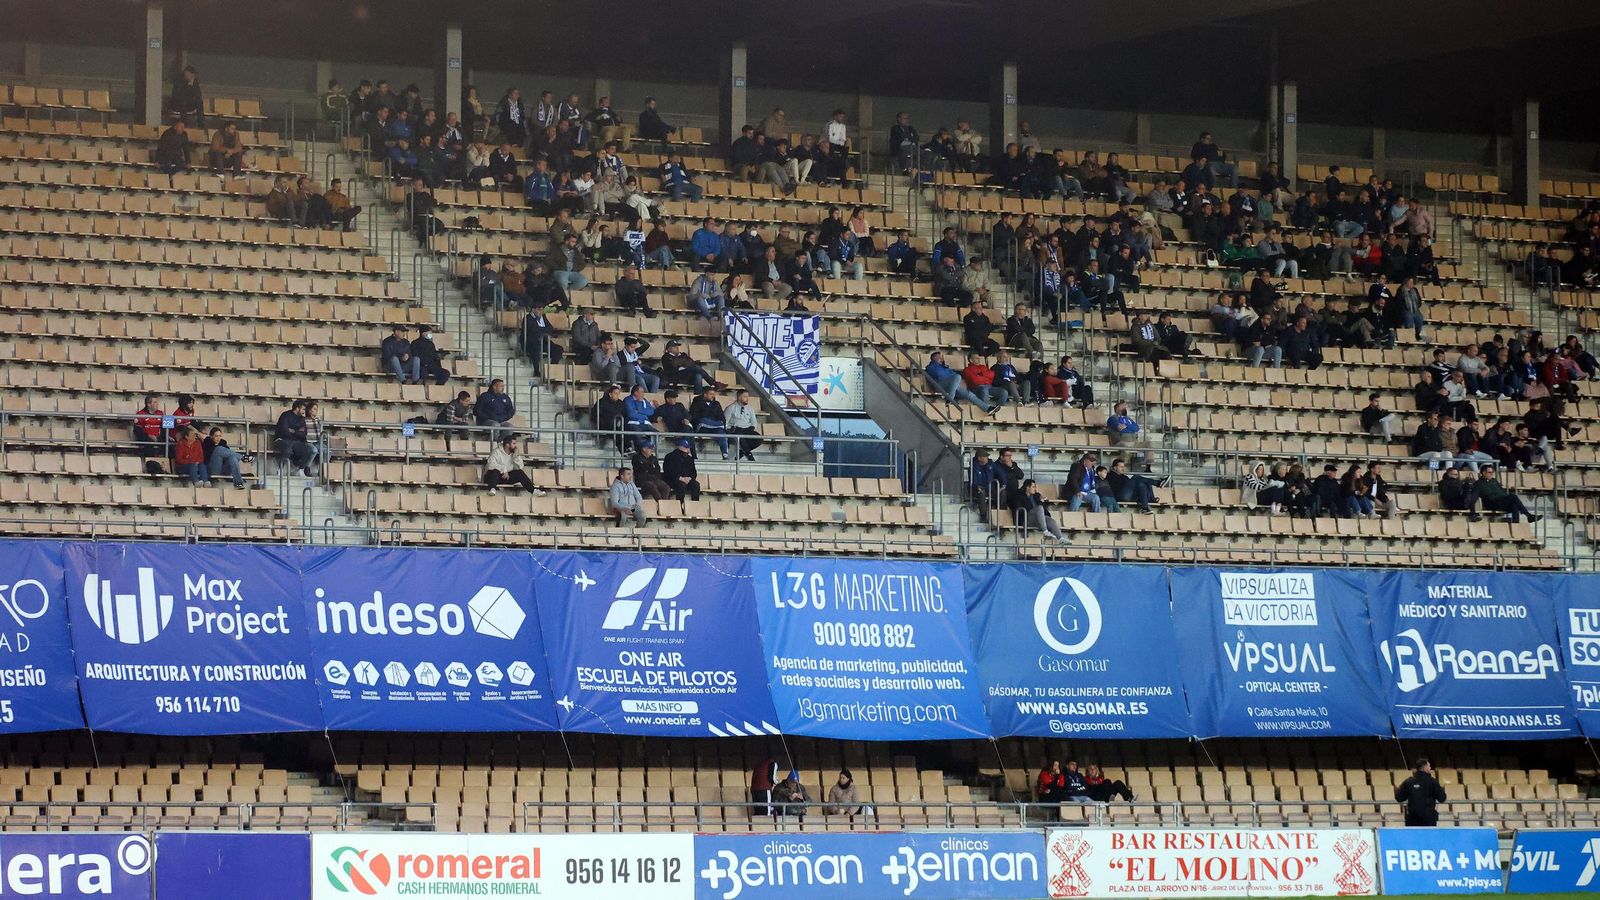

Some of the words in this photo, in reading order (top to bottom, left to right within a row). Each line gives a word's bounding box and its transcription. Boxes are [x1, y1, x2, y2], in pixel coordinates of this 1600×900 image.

[184, 574, 243, 601] Max
[771, 572, 826, 609] L3G
[834, 573, 948, 613] MARKETING.
[1224, 578, 1308, 595] VIPSUALIZA
[1428, 585, 1492, 599] MATERIAL
[315, 588, 465, 636] indeso
[642, 601, 692, 631] Air
[1058, 604, 1080, 632] G
[1226, 604, 1243, 620] LA
[1244, 604, 1314, 620] VICTORIA
[1399, 602, 1446, 618] MÉDICO
[1448, 604, 1458, 617] Y
[1460, 604, 1527, 618] SANITARIO
[186, 606, 290, 640] Project
[814, 622, 846, 646] 900
[850, 623, 880, 648] 908
[884, 624, 916, 648] 882
[619, 651, 654, 666] ONE
[658, 652, 684, 667] AIR
[773, 656, 817, 670] Agencia
[820, 658, 833, 671] de
[836, 658, 900, 675] marketing,
[902, 660, 968, 675] publicidad,
[1038, 655, 1110, 672] Gasomar
[86, 662, 188, 682] ARQUITECTURA
[192, 665, 201, 682] Y
[204, 661, 307, 682] CONSTRUCIÓN
[576, 667, 644, 684] ESCUELA
[646, 670, 667, 685] DE
[670, 671, 737, 686] PILOTOS
[580, 683, 618, 692] Bienvenidos
[782, 674, 812, 686] redes
[814, 675, 860, 688] sociales
[863, 678, 869, 692] y
[872, 676, 933, 690] desarrollo
[936, 677, 965, 690] web.
[1034, 688, 1046, 696] TU
[1048, 688, 1103, 696] GASOLINERA
[1106, 688, 1118, 696] DE
[1120, 686, 1172, 696] CONFIANZA
[1246, 682, 1284, 692] OPTICAL
[1284, 682, 1320, 692] CENTER
[156, 696, 182, 713] 956
[186, 697, 211, 713] 114
[214, 696, 240, 713] 710
[1572, 685, 1600, 707] 7pl
[658, 703, 682, 712] INFO
[1016, 702, 1148, 715] WWW.GASOMAR.ES
[1254, 708, 1273, 716] Calle
[1274, 708, 1295, 716] Santa
[1319, 707, 1328, 716] 10
[1254, 720, 1331, 730] WWW.VIPSUAL.COM
[1403, 713, 1562, 726] WWW.LATIENDAROANSA.ES
[764, 840, 812, 854] clínicas
[941, 837, 988, 850] clínicas
[1111, 832, 1156, 850] BAR
[1164, 832, 1319, 850] RESTAURANTE
[398, 848, 541, 879] romeral
[1386, 850, 1453, 871] FIBRA
[0, 852, 112, 895] era
[566, 858, 604, 884] 956
[610, 858, 630, 884] 14
[637, 858, 656, 883] 16
[662, 857, 681, 882] 12
[398, 882, 426, 895] CASH
[428, 882, 488, 895] HERMANOS
[491, 882, 542, 894] ROMERAL
[1437, 877, 1502, 889] www.7play.es
